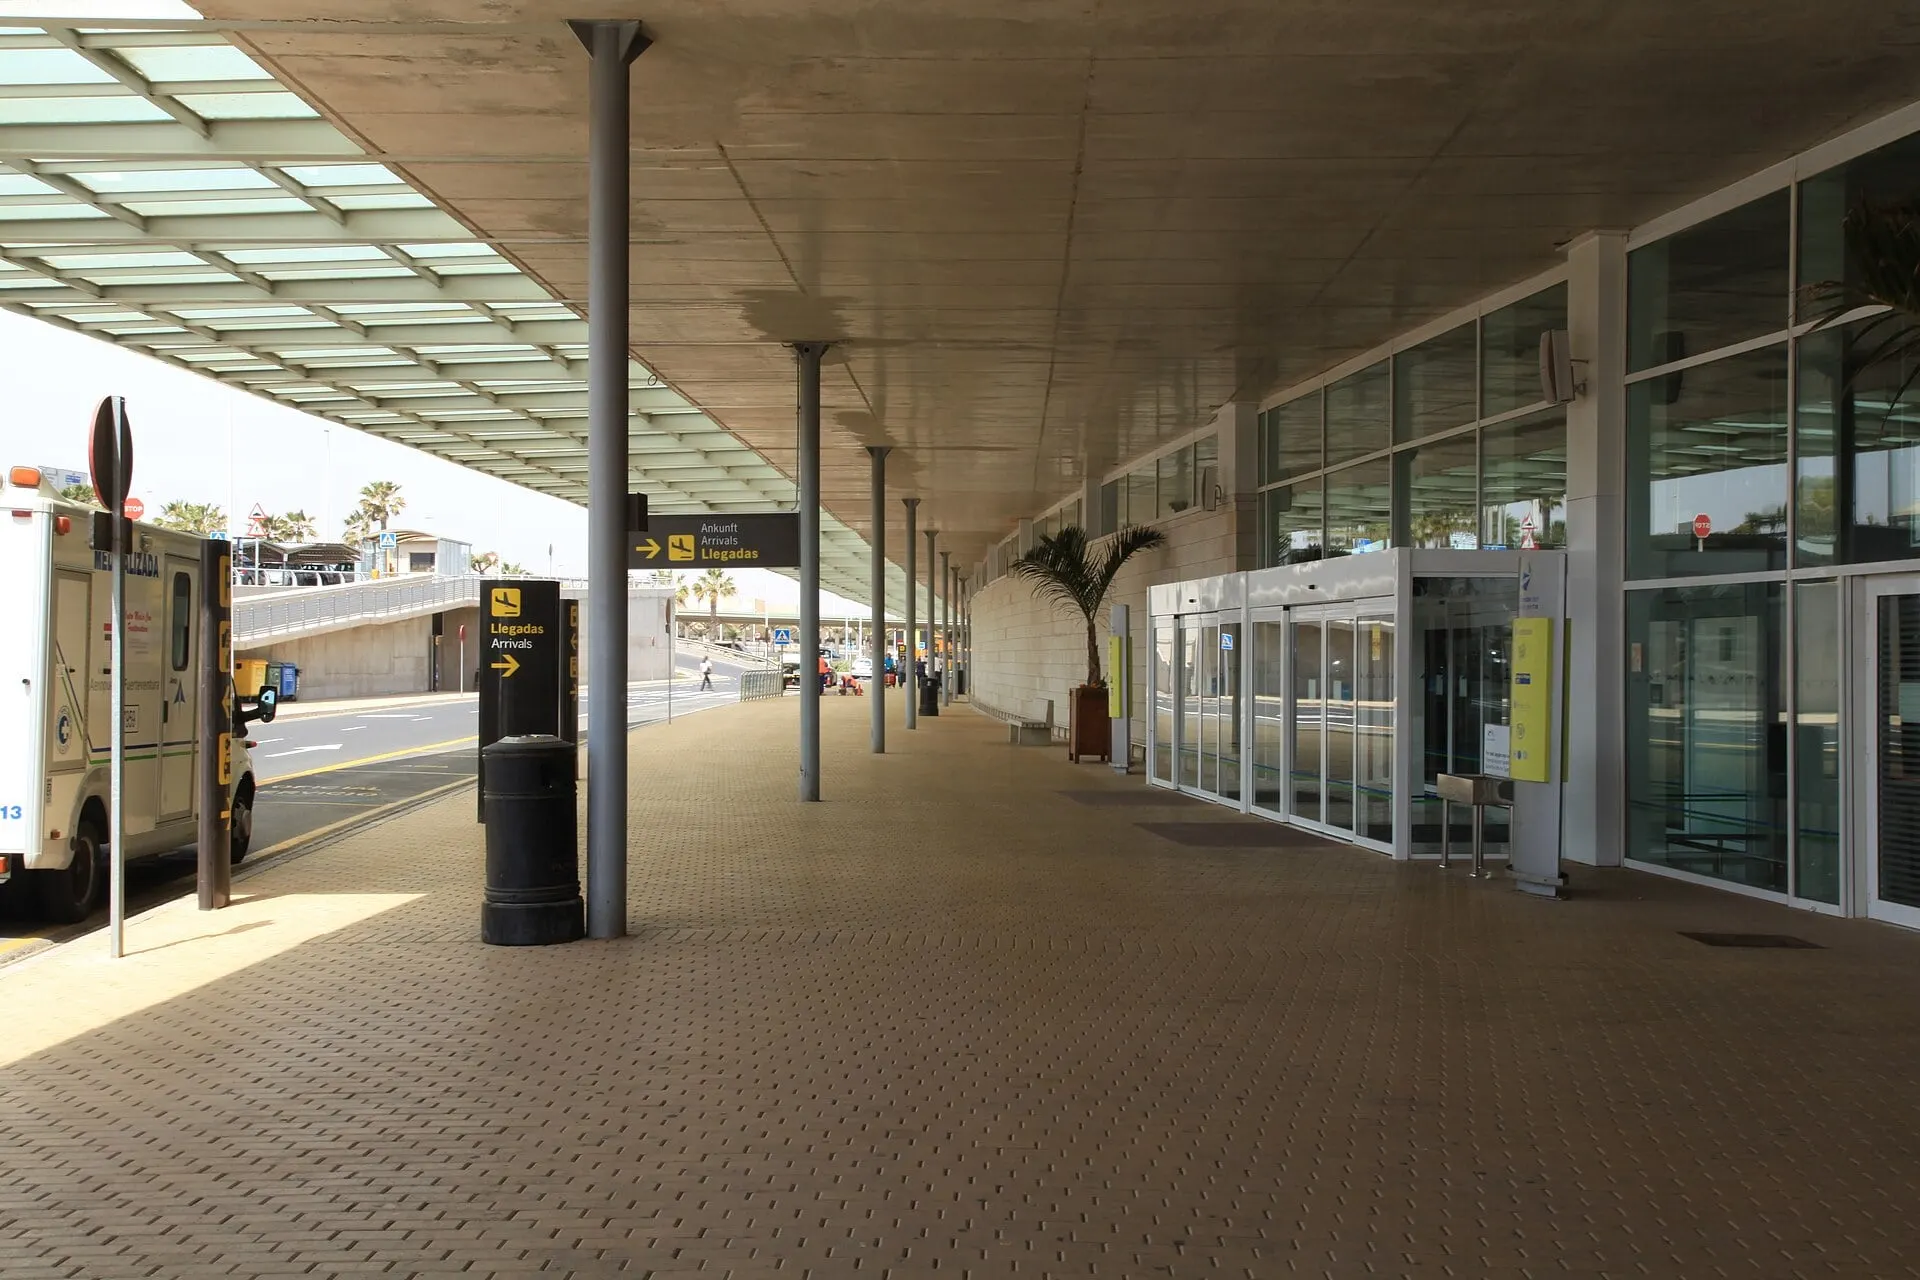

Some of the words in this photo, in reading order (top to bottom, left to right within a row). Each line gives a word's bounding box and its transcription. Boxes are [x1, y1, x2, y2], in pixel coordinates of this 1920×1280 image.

[701, 522, 738, 533] Ankunft
[701, 535, 738, 546] Arrivals
[701, 547, 759, 562] Llegadas
[95, 550, 159, 578] MEDALIZADA
[491, 623, 544, 636] Llegadas
[491, 638, 533, 649] Arrivals
